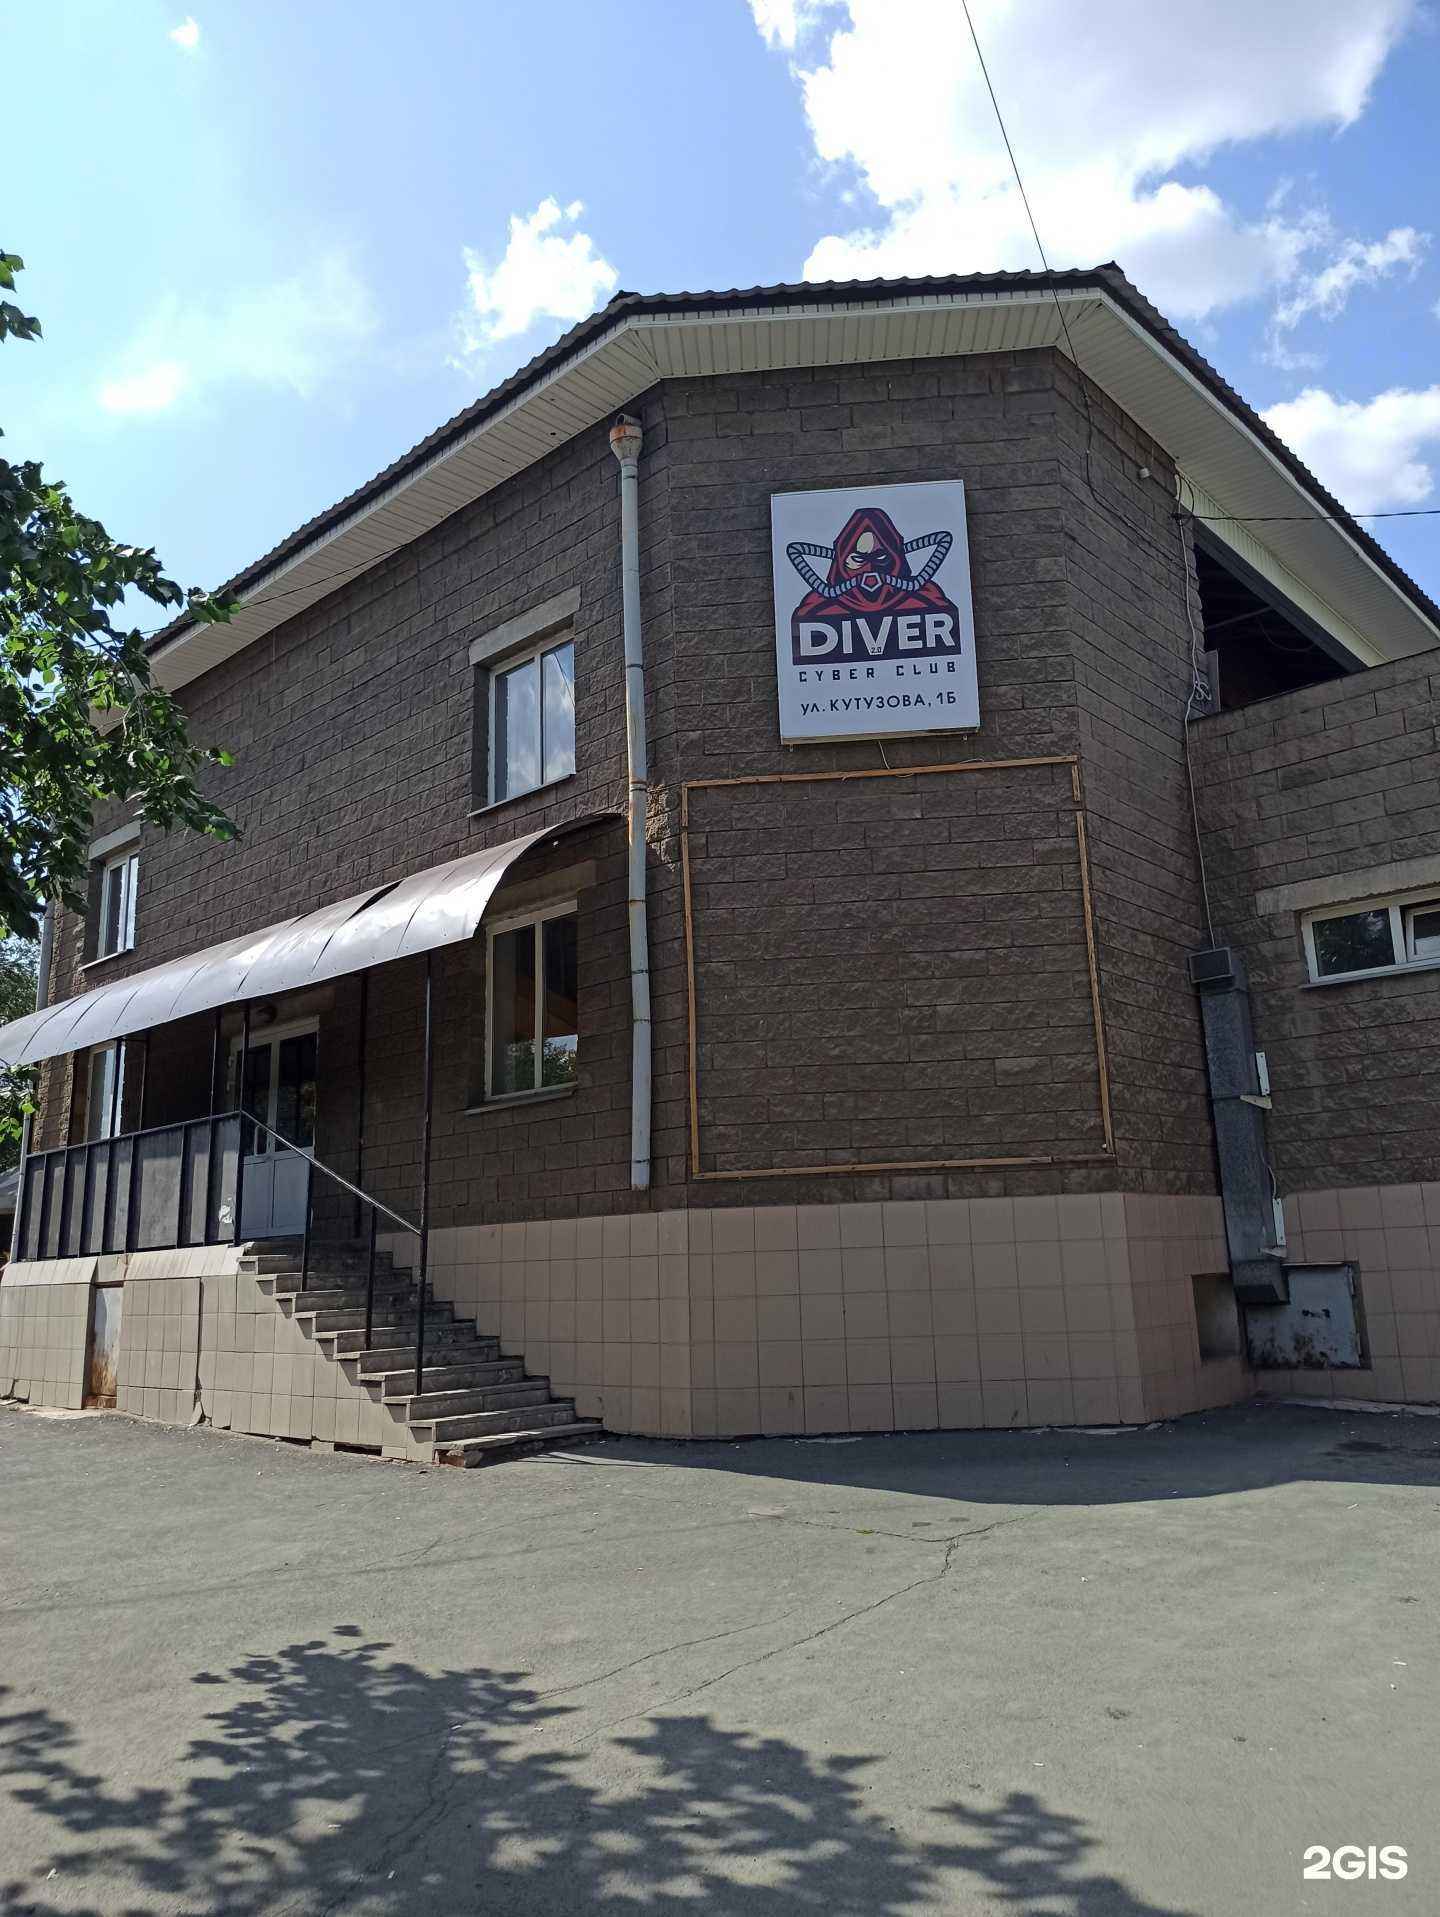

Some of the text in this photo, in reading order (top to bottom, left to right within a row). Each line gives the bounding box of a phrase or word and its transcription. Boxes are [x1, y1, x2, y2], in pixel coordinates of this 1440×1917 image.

[799, 613, 955, 656] DIVER
[799, 661, 956, 682] CYBER CLUB
[936, 691, 956, 705] 1Б
